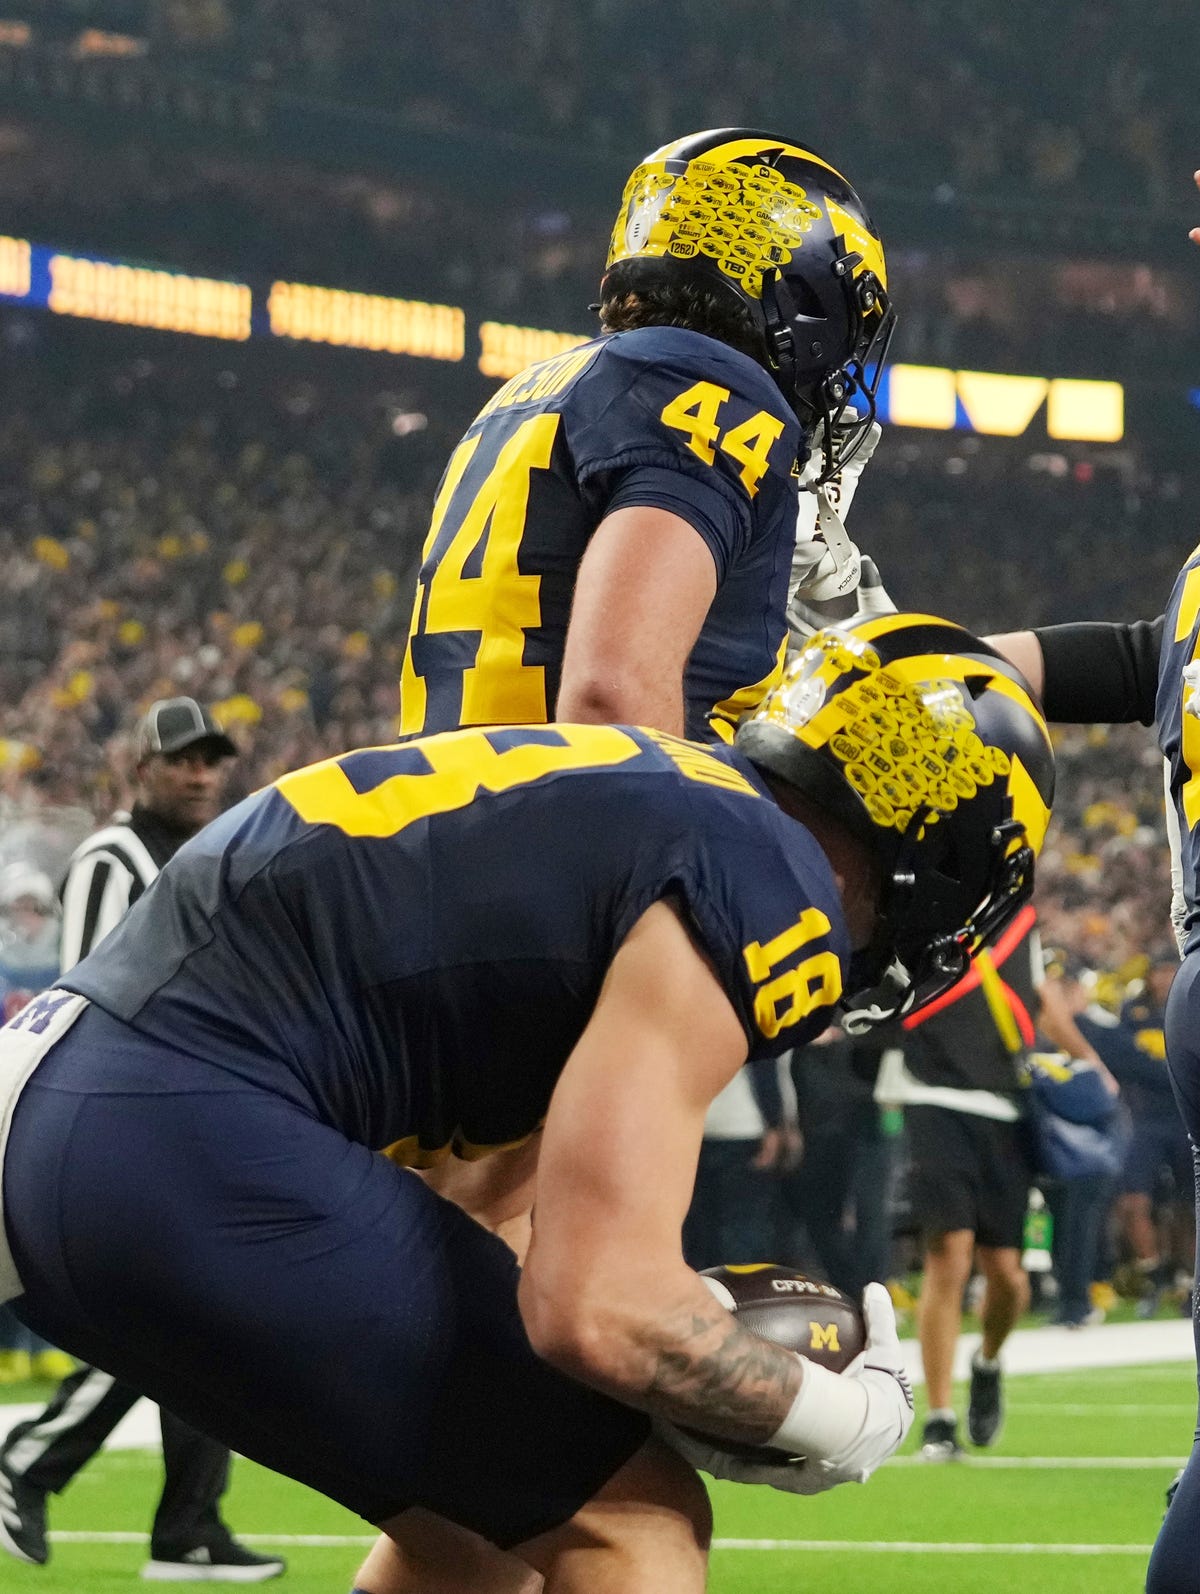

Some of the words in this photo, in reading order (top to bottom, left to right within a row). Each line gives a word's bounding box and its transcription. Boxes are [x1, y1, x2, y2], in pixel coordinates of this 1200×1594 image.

[725, 259, 746, 274] TED
[661, 381, 785, 499] 44
[869, 752, 892, 772] TED
[920, 755, 943, 776] TED
[744, 907, 843, 1038] 18
[810, 1322, 841, 1352] M
